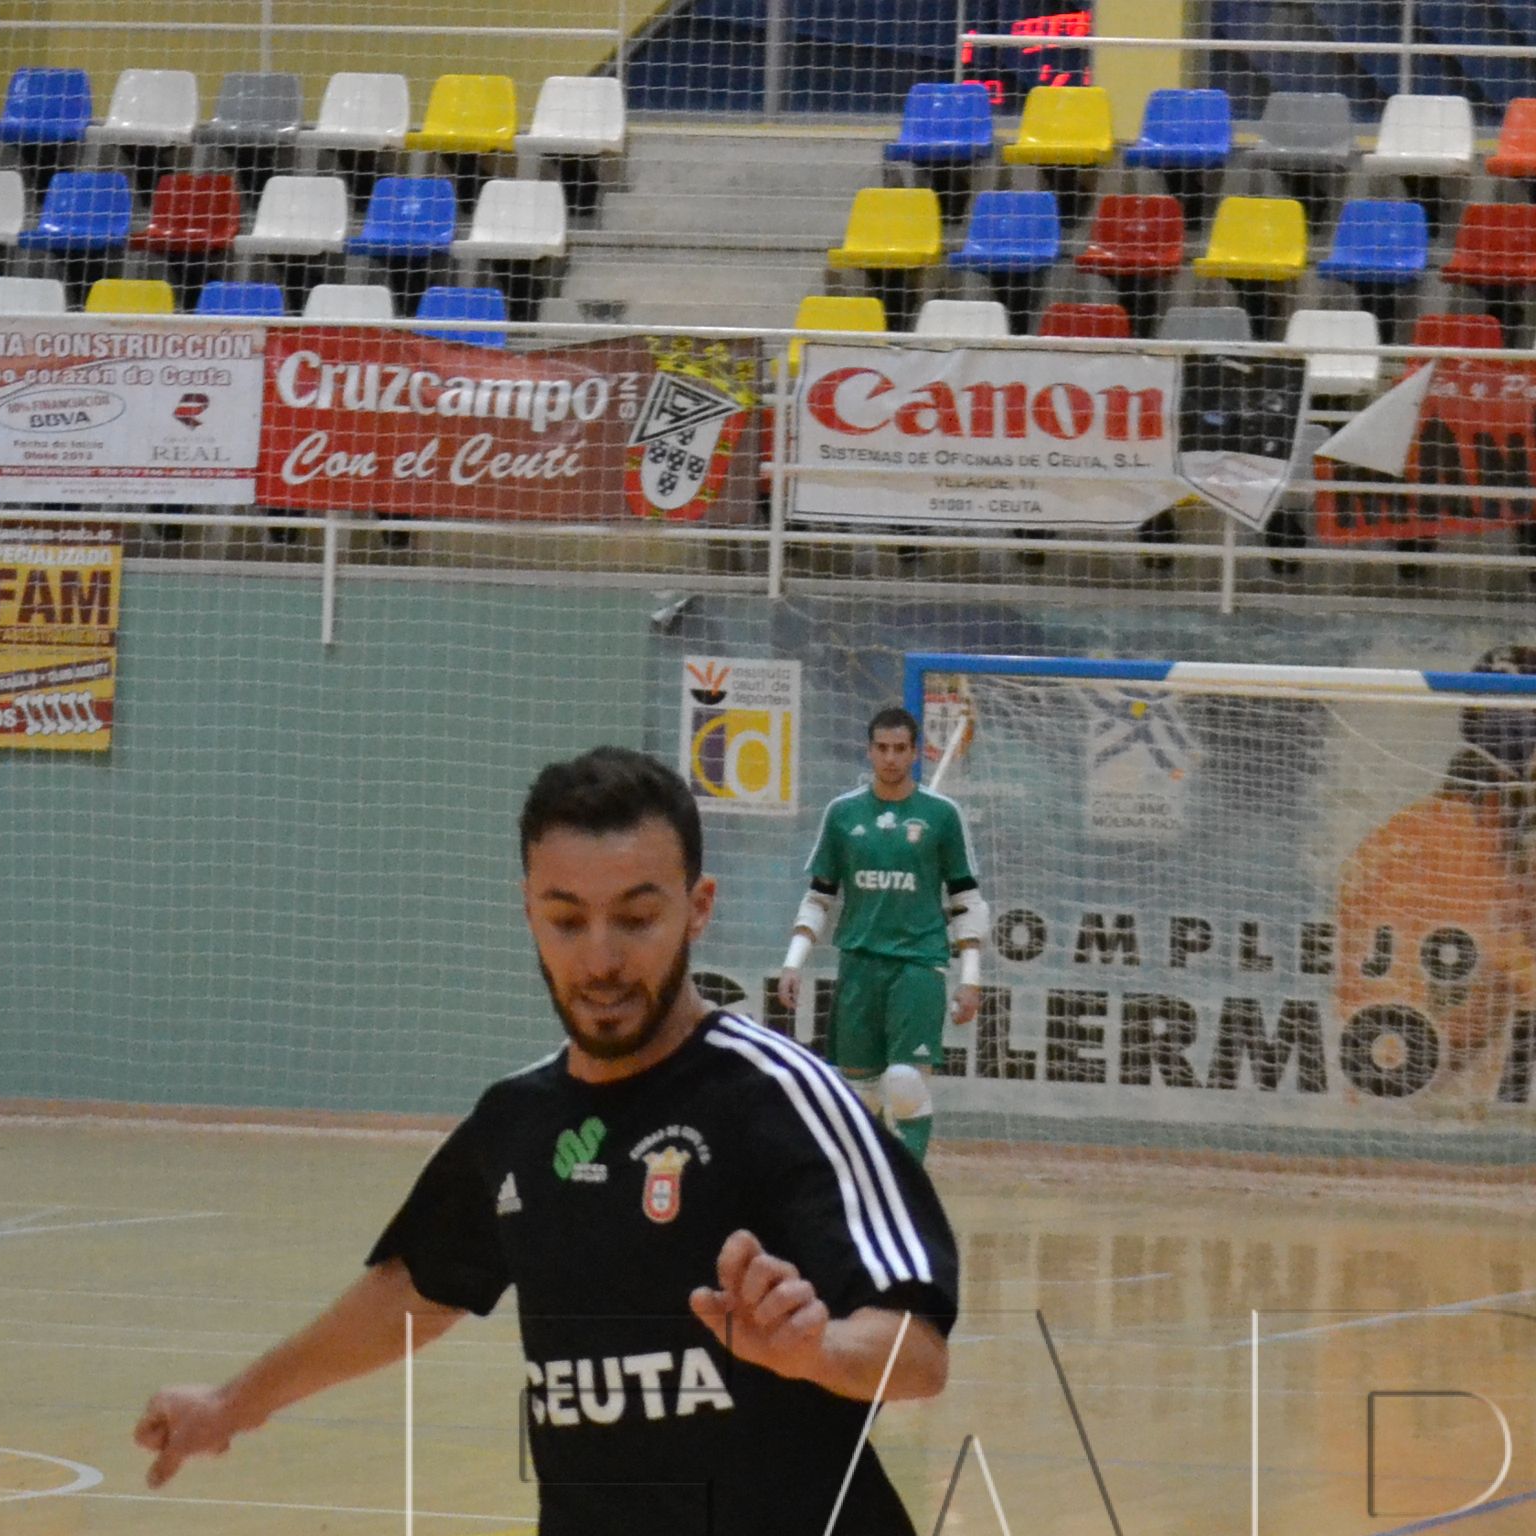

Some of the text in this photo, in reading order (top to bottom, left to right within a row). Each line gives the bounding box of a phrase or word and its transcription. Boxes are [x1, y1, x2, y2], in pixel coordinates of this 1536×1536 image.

[35, 331, 252, 359] CONSTRUCCIÓN
[123, 366, 153, 385] de
[161, 367, 231, 386] Ceuta
[276, 351, 610, 433] Cruzcampo
[620, 372, 640, 420] SIN
[807, 367, 1163, 441] Canon
[29, 411, 92, 428] BBVA
[151, 446, 230, 462] REAL
[282, 431, 376, 486] Con
[394, 439, 439, 479] el
[989, 499, 1042, 515] CEUTA
[854, 869, 916, 892] CEUTA
[950, 908, 1478, 981] OMPLEJO
